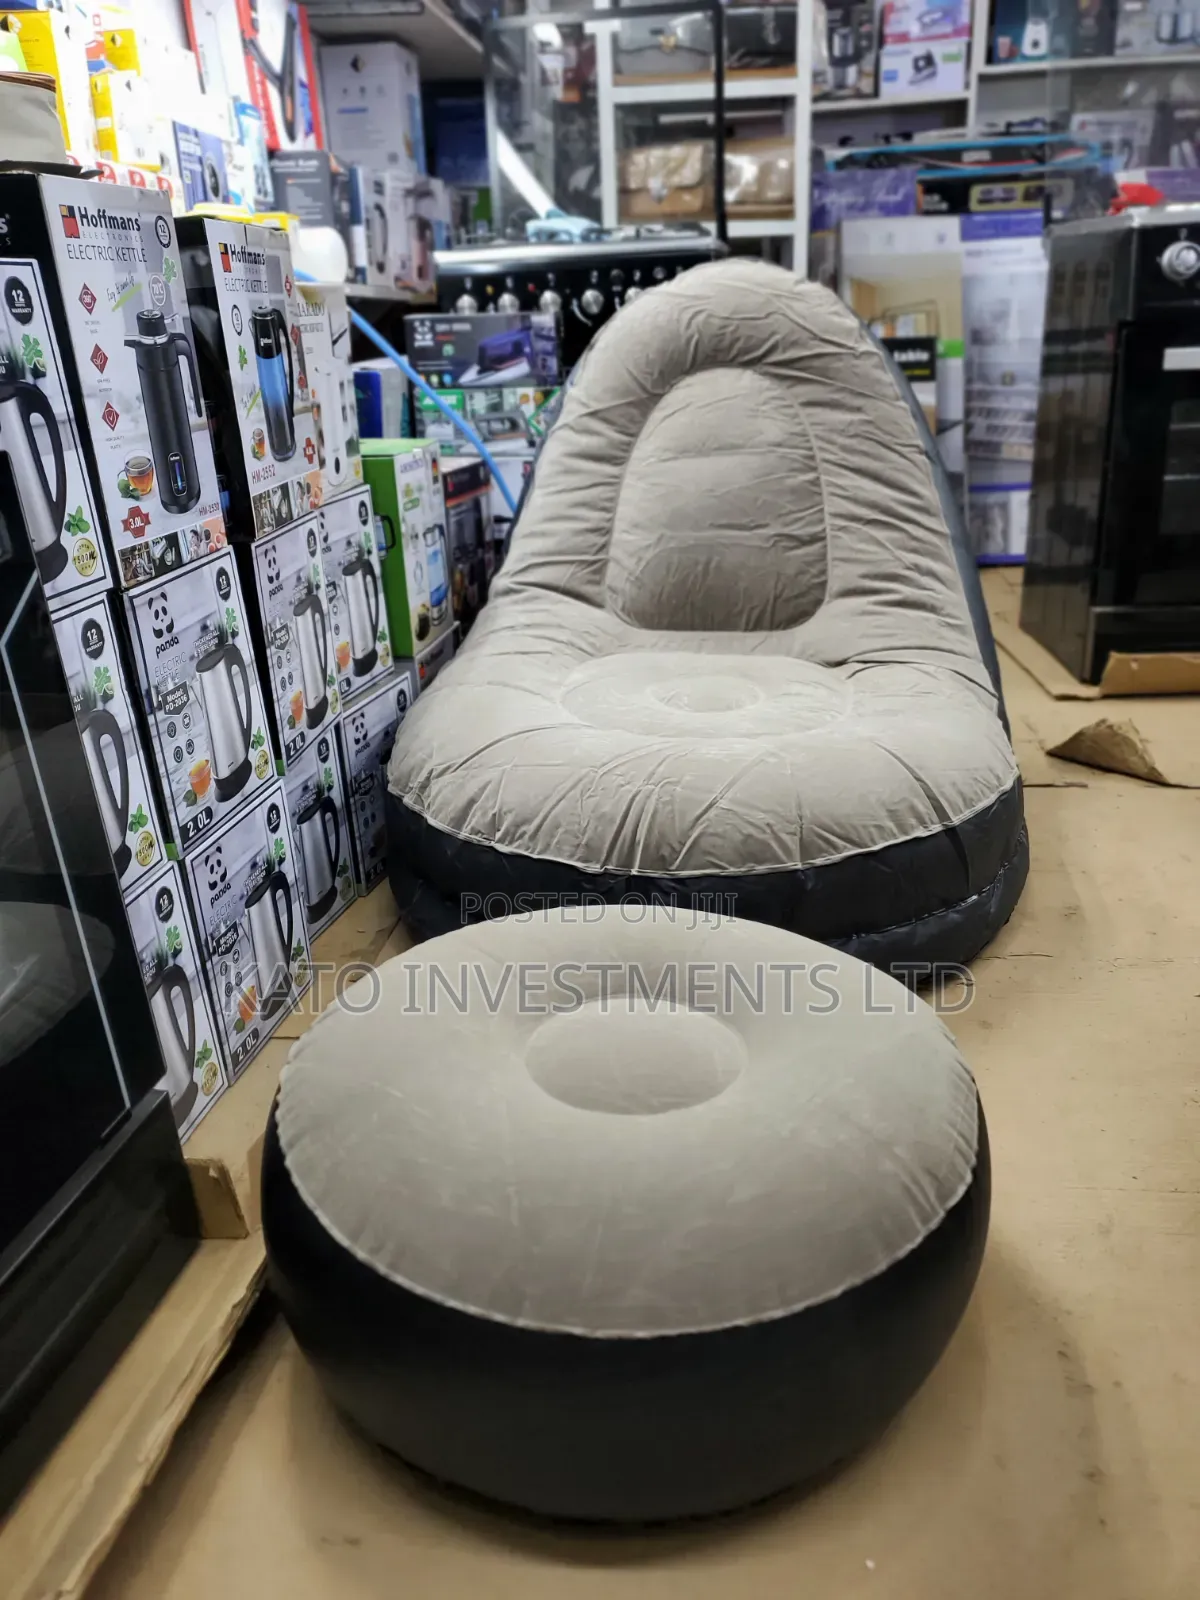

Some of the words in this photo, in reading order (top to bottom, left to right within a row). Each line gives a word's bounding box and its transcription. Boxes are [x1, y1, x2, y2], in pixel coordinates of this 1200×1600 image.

[78, 205, 141, 232] Hoffmans
[82, 231, 144, 243] ELECTRONICS
[66, 243, 115, 261] ELECTRIC
[115, 246, 148, 263] KETTLE
[229, 243, 266, 266] Hoffmans
[224, 277, 251, 293] ELECTRIC
[11, 289, 25, 302] 12
[129, 516, 144, 529] 3.0L
[219, 575, 227, 588] 12
[86, 628, 98, 641] 12
[155, 635, 180, 660] panda
[154, 652, 187, 678] ELECTRIC
[166, 687, 184, 704] Model:
[339, 681, 348, 694] 0L
[159, 894, 169, 908] 12
[210, 882, 232, 909] panda
